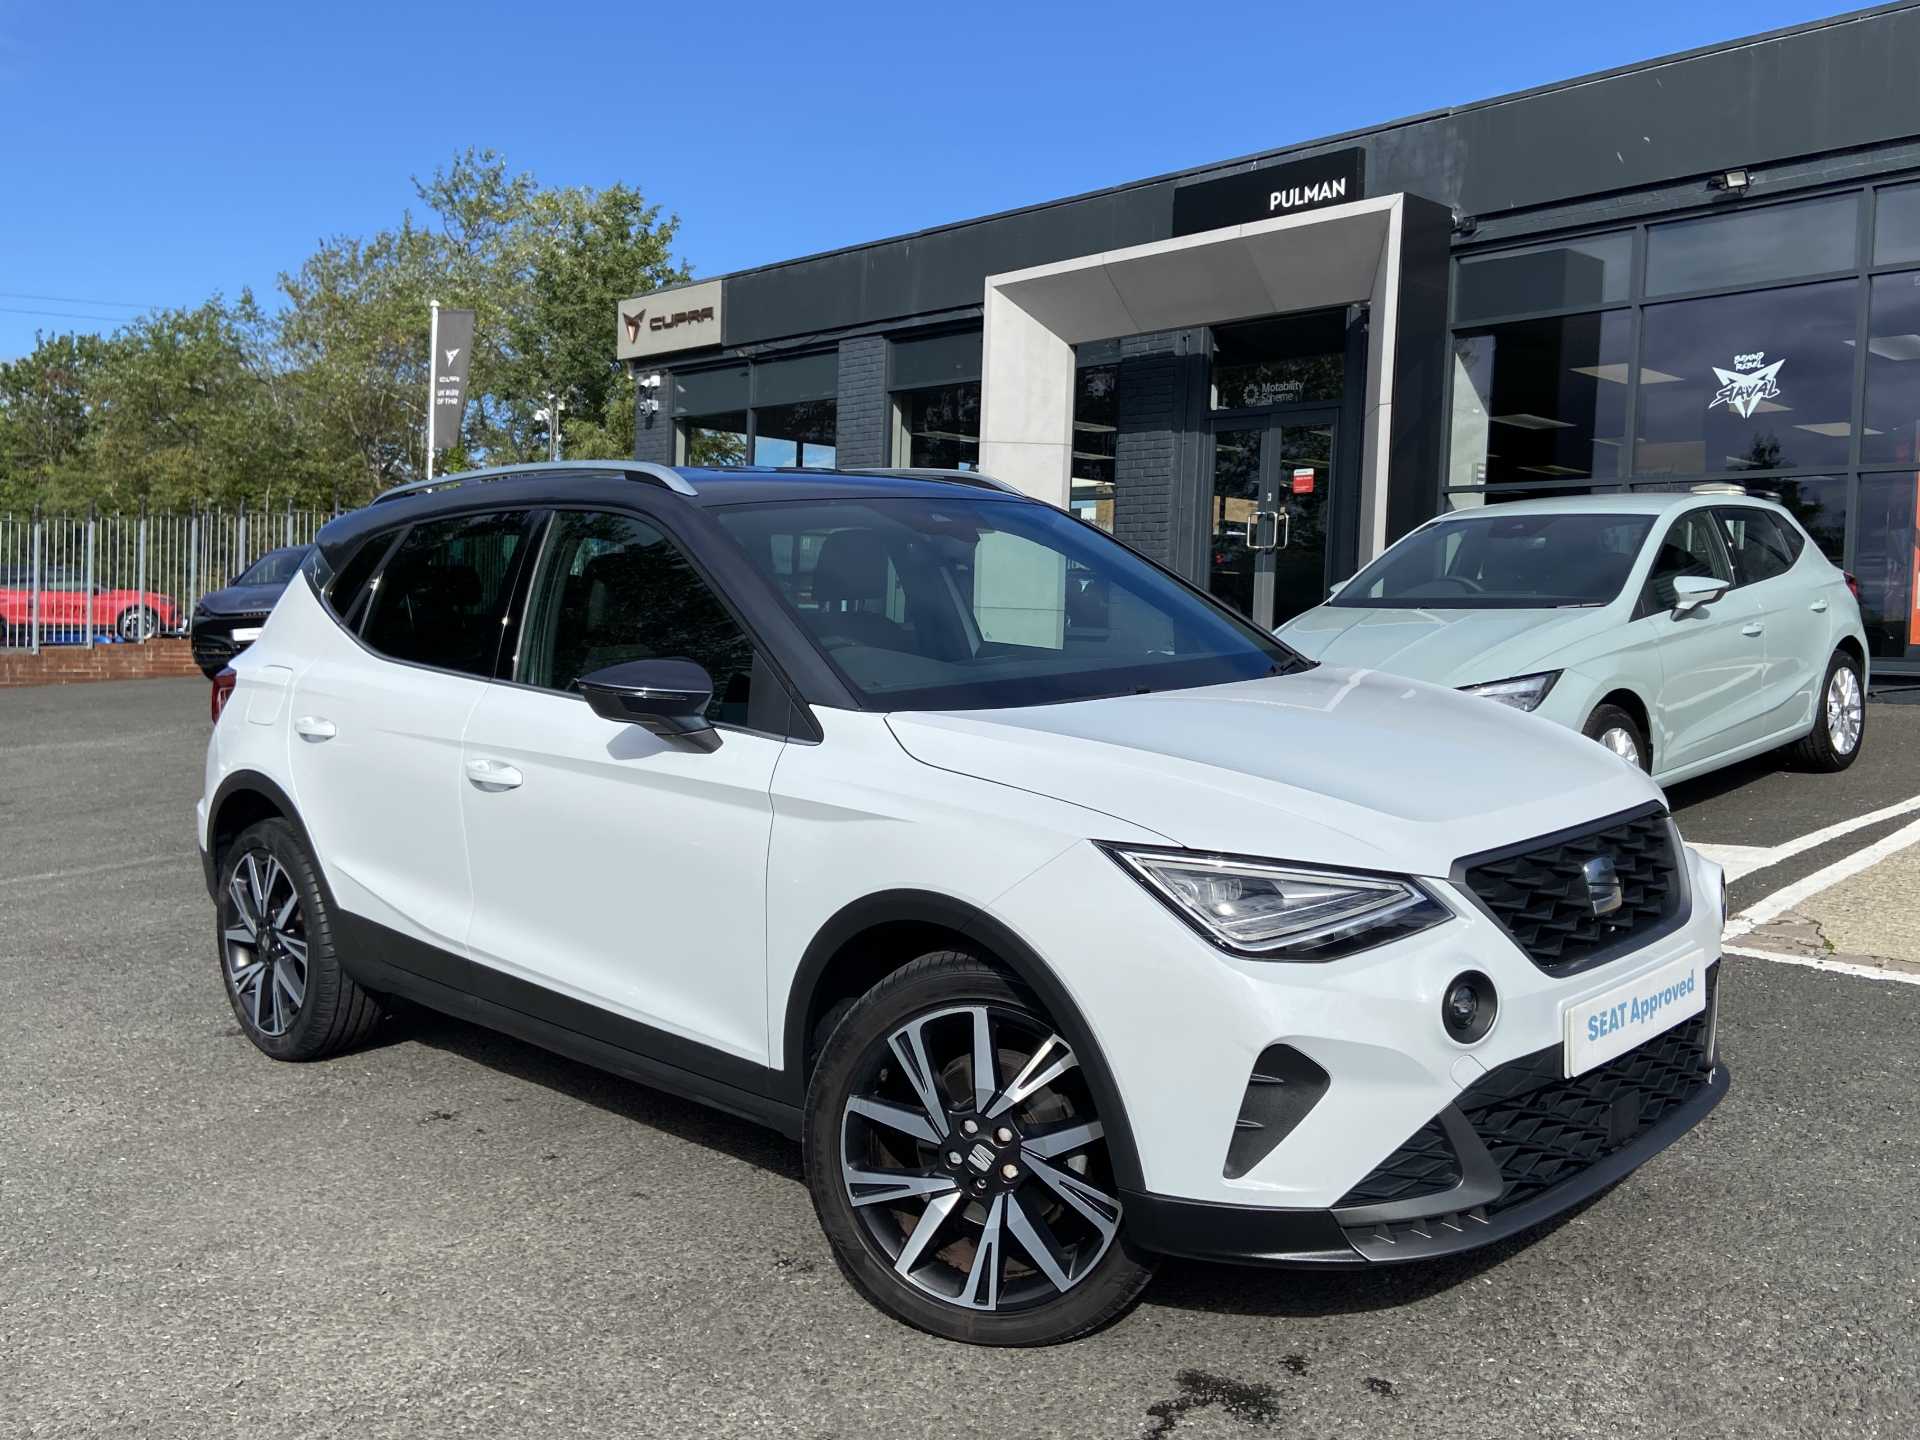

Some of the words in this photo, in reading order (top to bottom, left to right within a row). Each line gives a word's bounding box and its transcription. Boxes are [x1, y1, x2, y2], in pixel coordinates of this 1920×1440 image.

[1270, 177, 1346, 211] PULMAN
[649, 306, 714, 332] CUPRA
[1261, 380, 1305, 393] Motability
[1587, 1001, 1627, 1042] SEAT
[1630, 968, 1696, 1024] Approved
